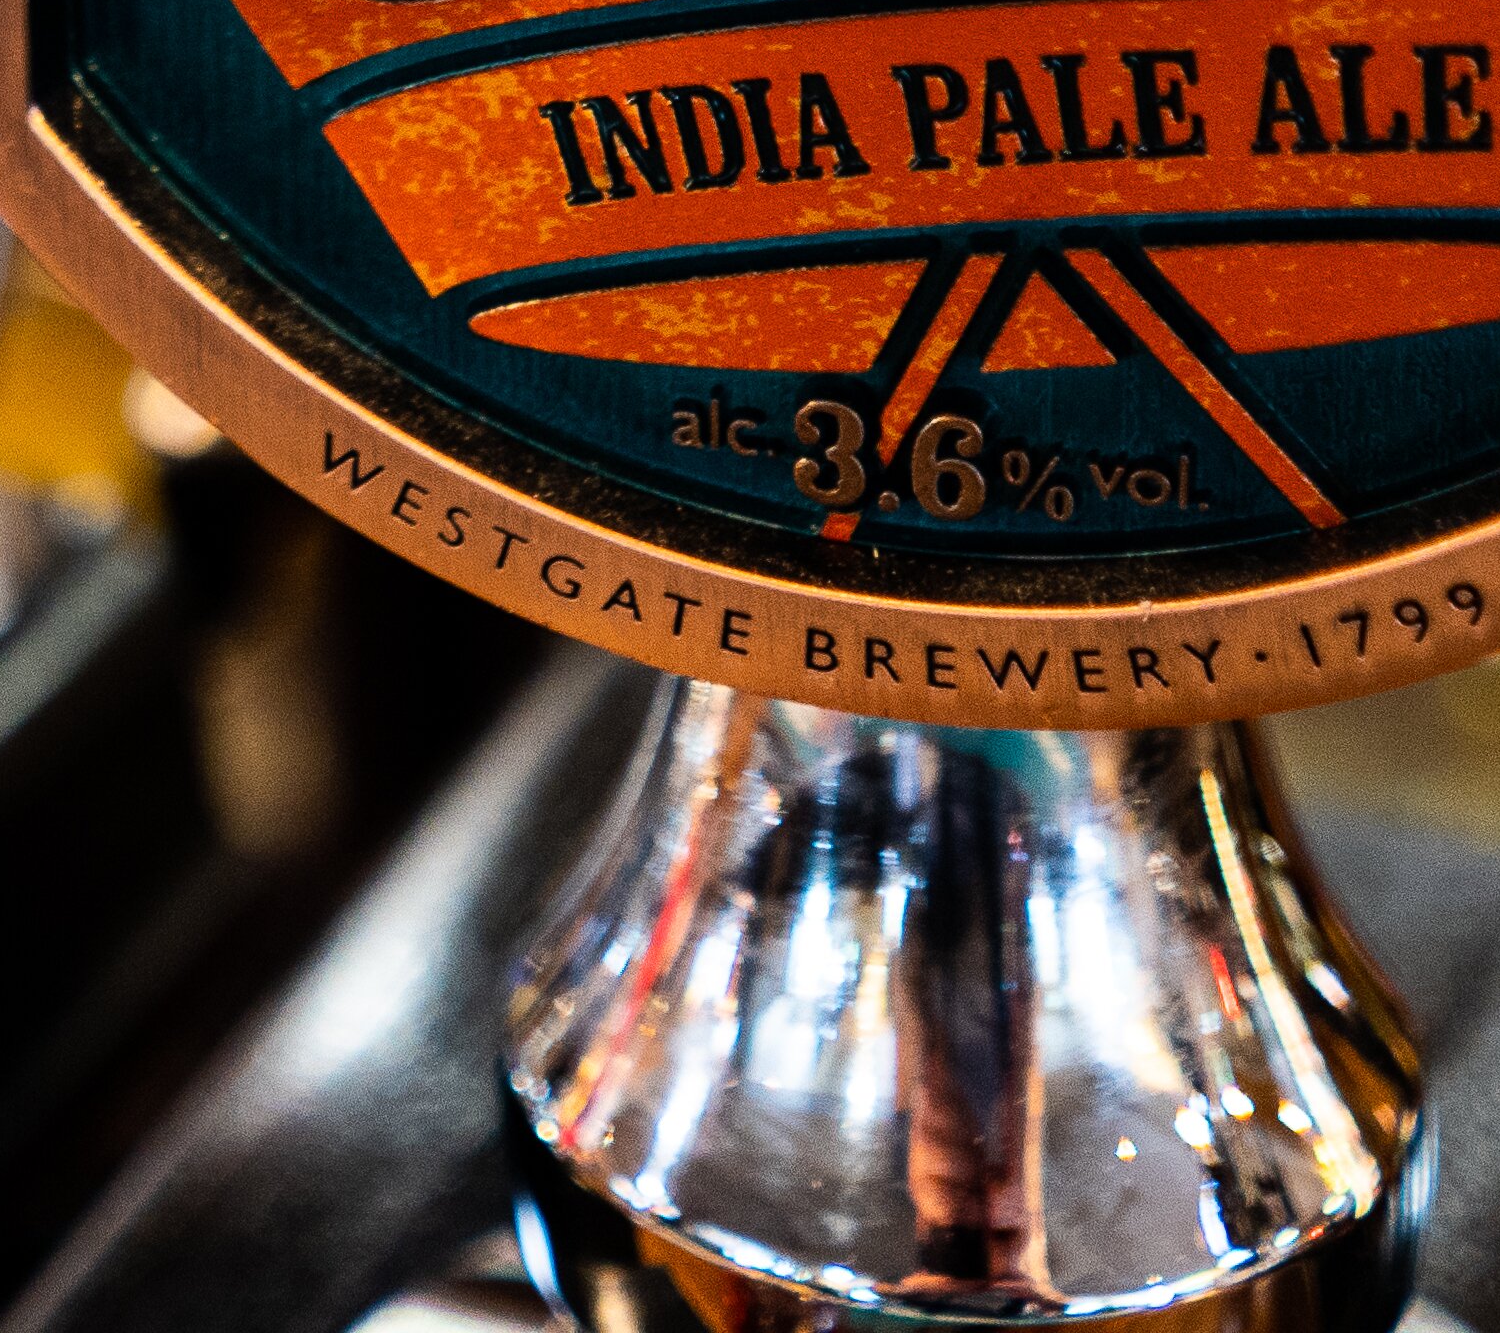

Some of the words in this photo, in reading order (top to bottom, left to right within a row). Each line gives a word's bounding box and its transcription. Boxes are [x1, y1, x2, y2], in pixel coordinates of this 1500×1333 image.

[538, 70, 872, 209] INDIA
[890, 47, 1207, 173] PALE
[1250, 43, 1496, 156] ALE
[671, 397, 777, 458] alc.
[1089, 453, 1211, 513] vol.
[322, 431, 754, 656] WESTGATE
